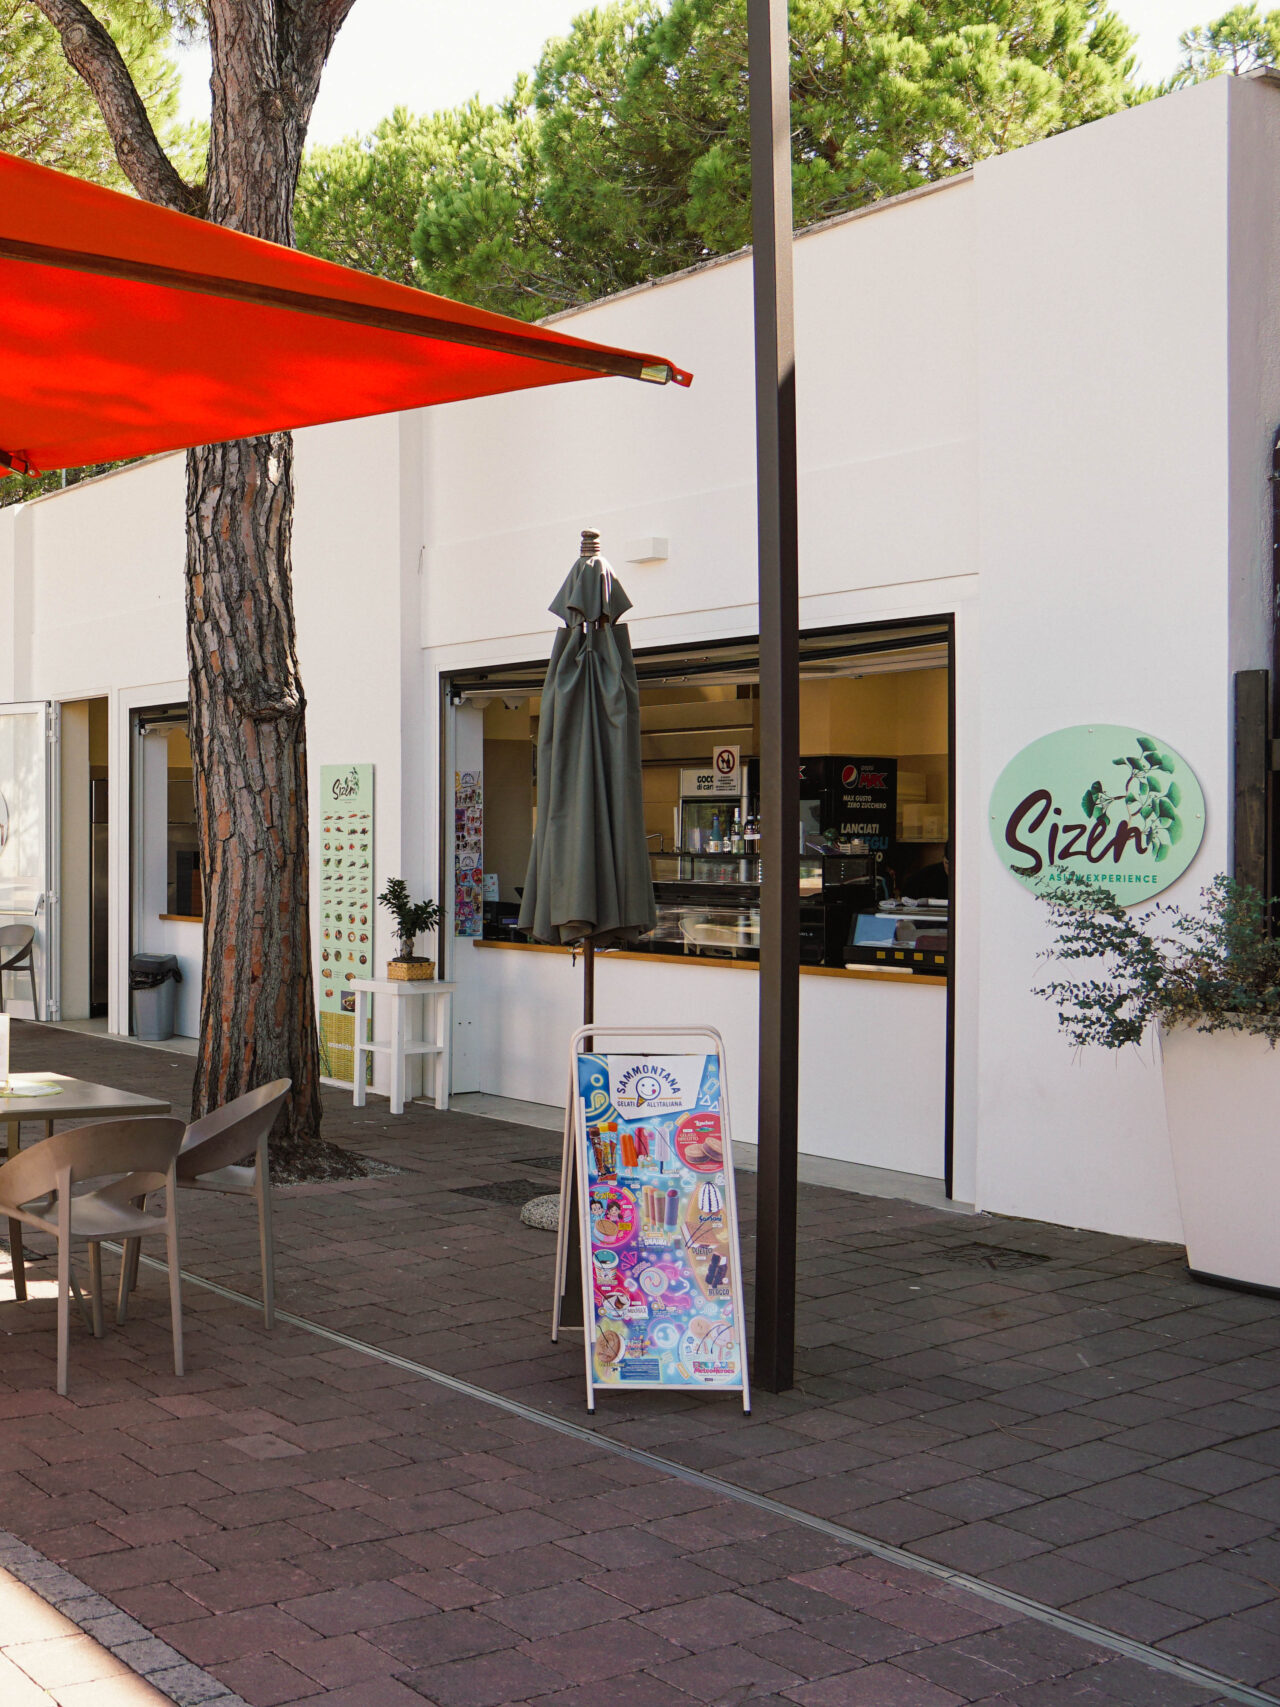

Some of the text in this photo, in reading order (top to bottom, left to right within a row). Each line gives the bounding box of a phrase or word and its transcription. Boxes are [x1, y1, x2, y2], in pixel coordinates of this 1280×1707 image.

[840, 824, 879, 833] LANCIATI
[1005, 789, 1148, 876] Sizen
[1048, 873, 1158, 884] ASIN EXPERIENCE
[616, 1064, 682, 1095] SAMMONTANA
